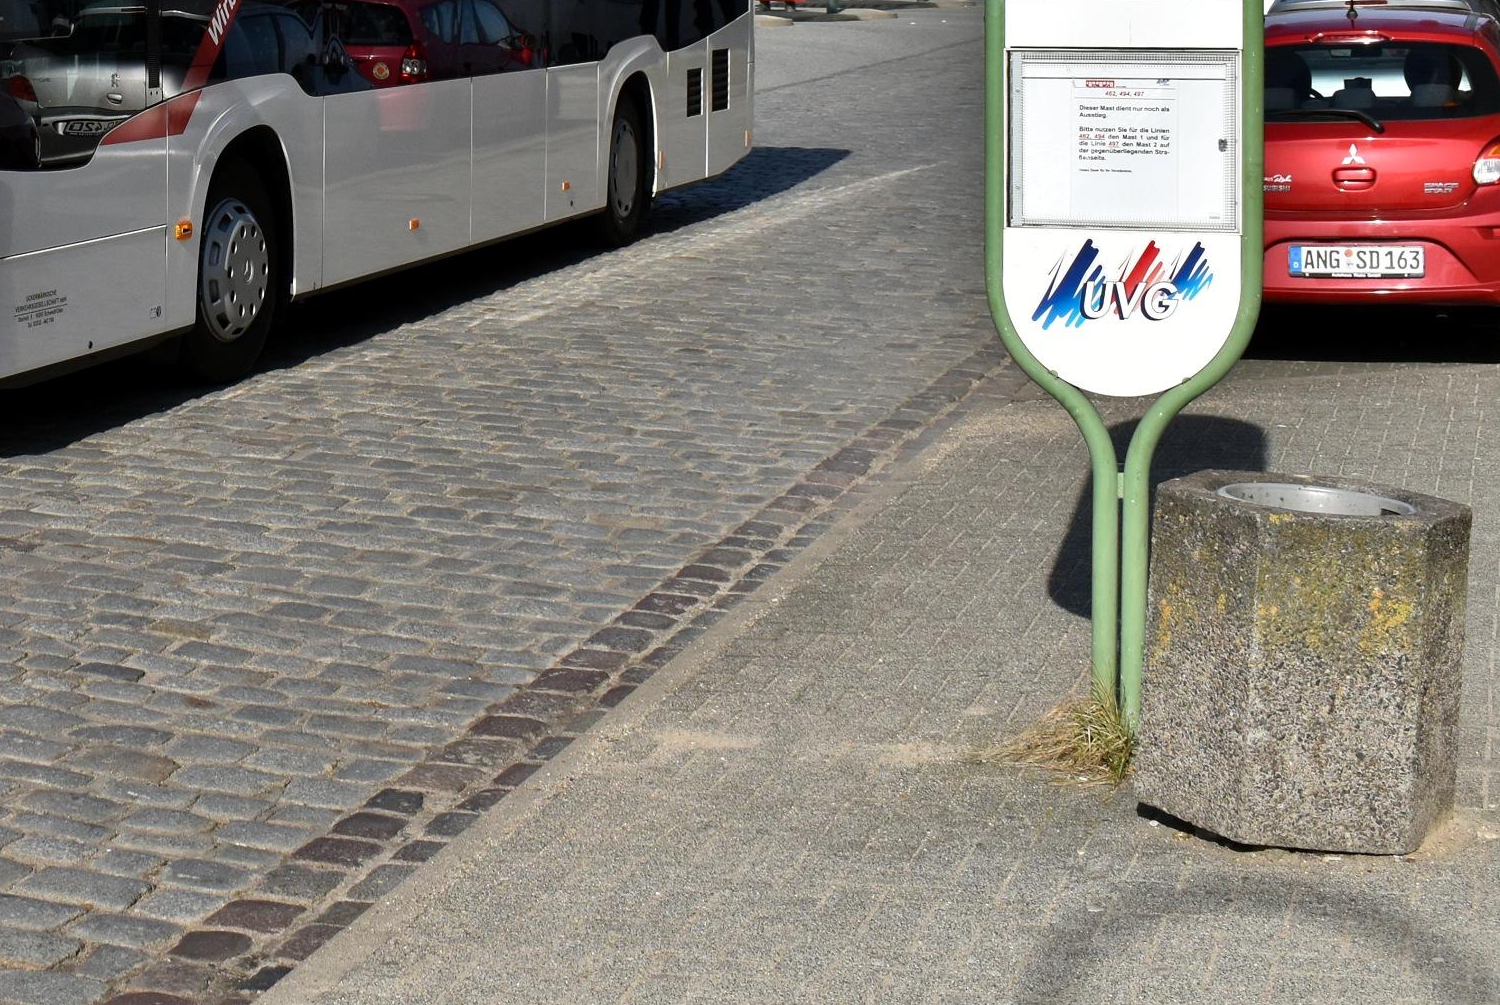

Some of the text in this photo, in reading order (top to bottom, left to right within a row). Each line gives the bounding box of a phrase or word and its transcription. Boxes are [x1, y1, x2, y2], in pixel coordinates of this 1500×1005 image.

[1303, 249, 1340, 270] ANG
[1356, 250, 1380, 270] SD
[1384, 250, 1420, 270] 163
